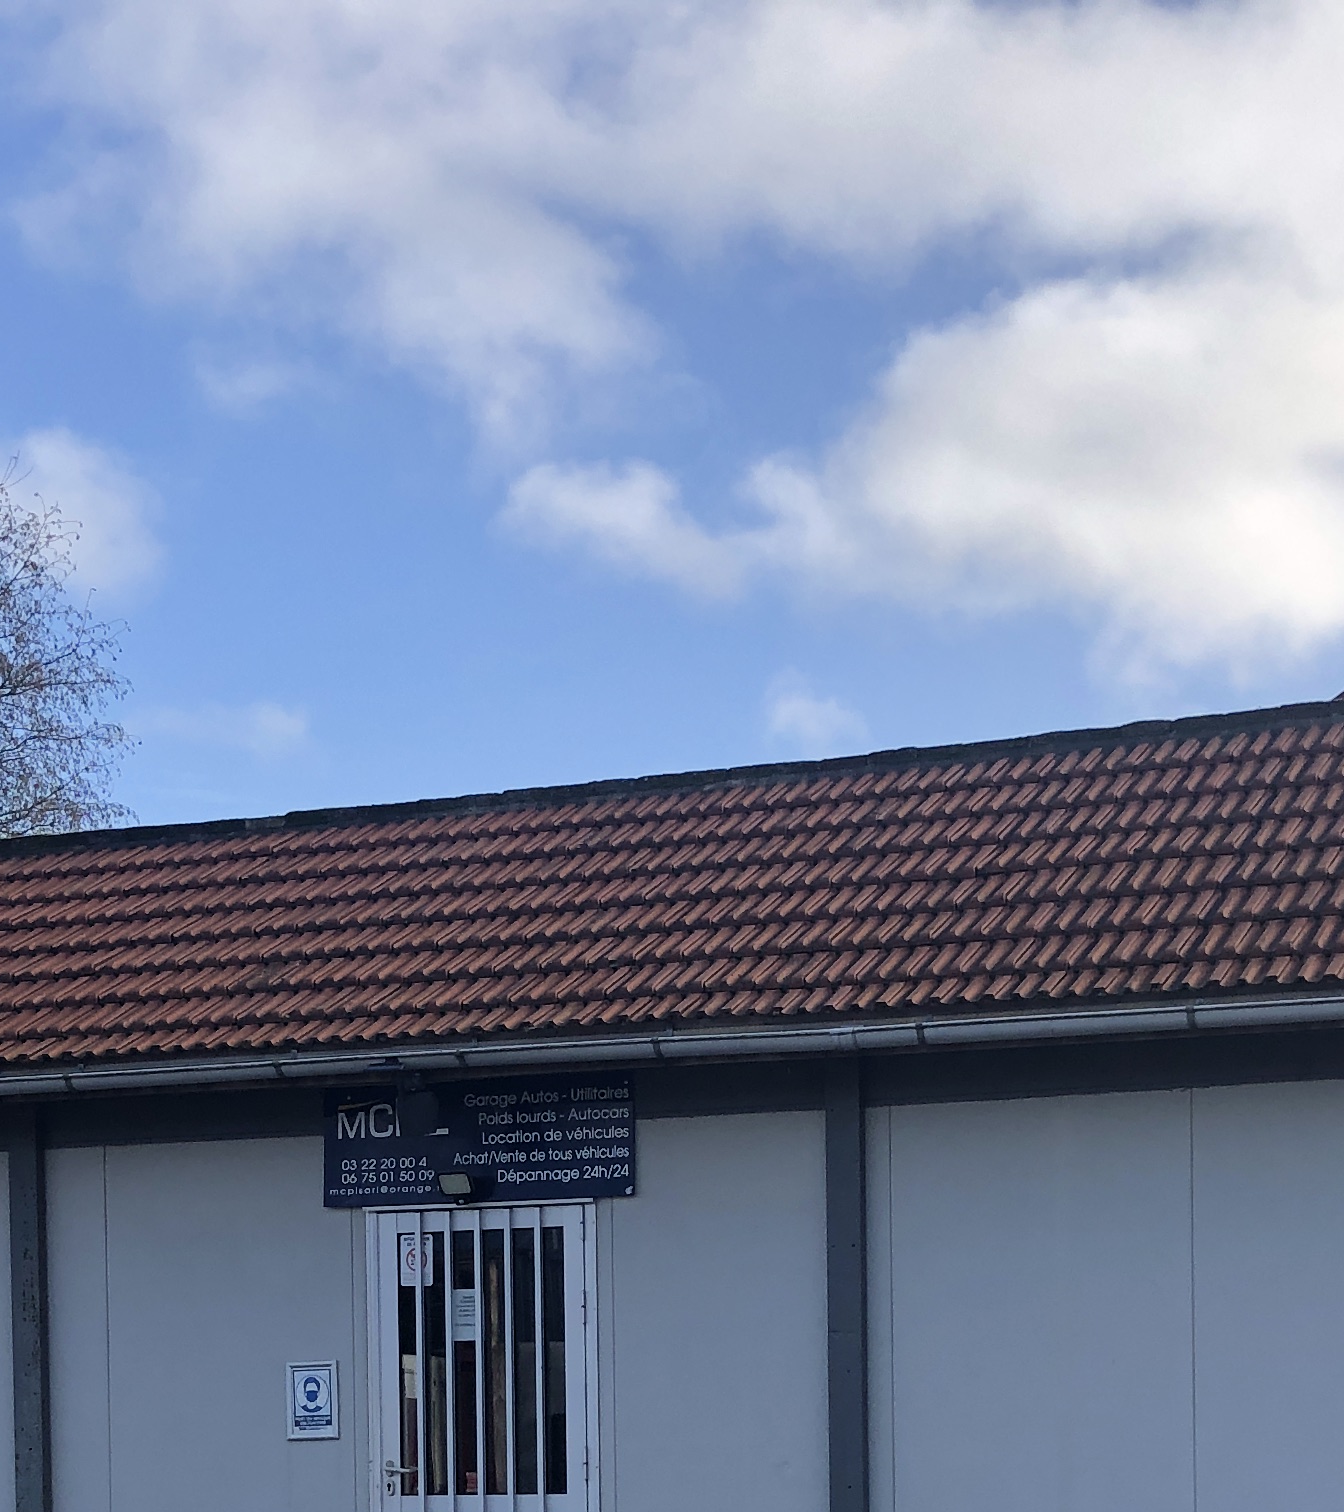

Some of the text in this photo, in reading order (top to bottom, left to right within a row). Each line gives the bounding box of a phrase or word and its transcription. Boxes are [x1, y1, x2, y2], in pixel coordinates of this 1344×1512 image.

[463, 1093, 517, 1108] Garage
[520, 1090, 559, 1104] Autos
[570, 1086, 630, 1102] Utilitaires
[478, 1112, 514, 1126] Poids
[516, 1109, 557, 1124] lourds
[568, 1107, 630, 1121] Autocars
[482, 1125, 630, 1145] Location de véhicules
[341, 1159, 358, 1171] 03
[361, 1158, 377, 1170] 22
[380, 1157, 396, 1169] 20
[399, 1157, 416, 1168] 00
[453, 1145, 630, 1166] Achat/Vente de tous véhicules
[341, 1169, 435, 1184] 06 75 01 50 09
[497, 1163, 630, 1184] Dépannage 24h/24
